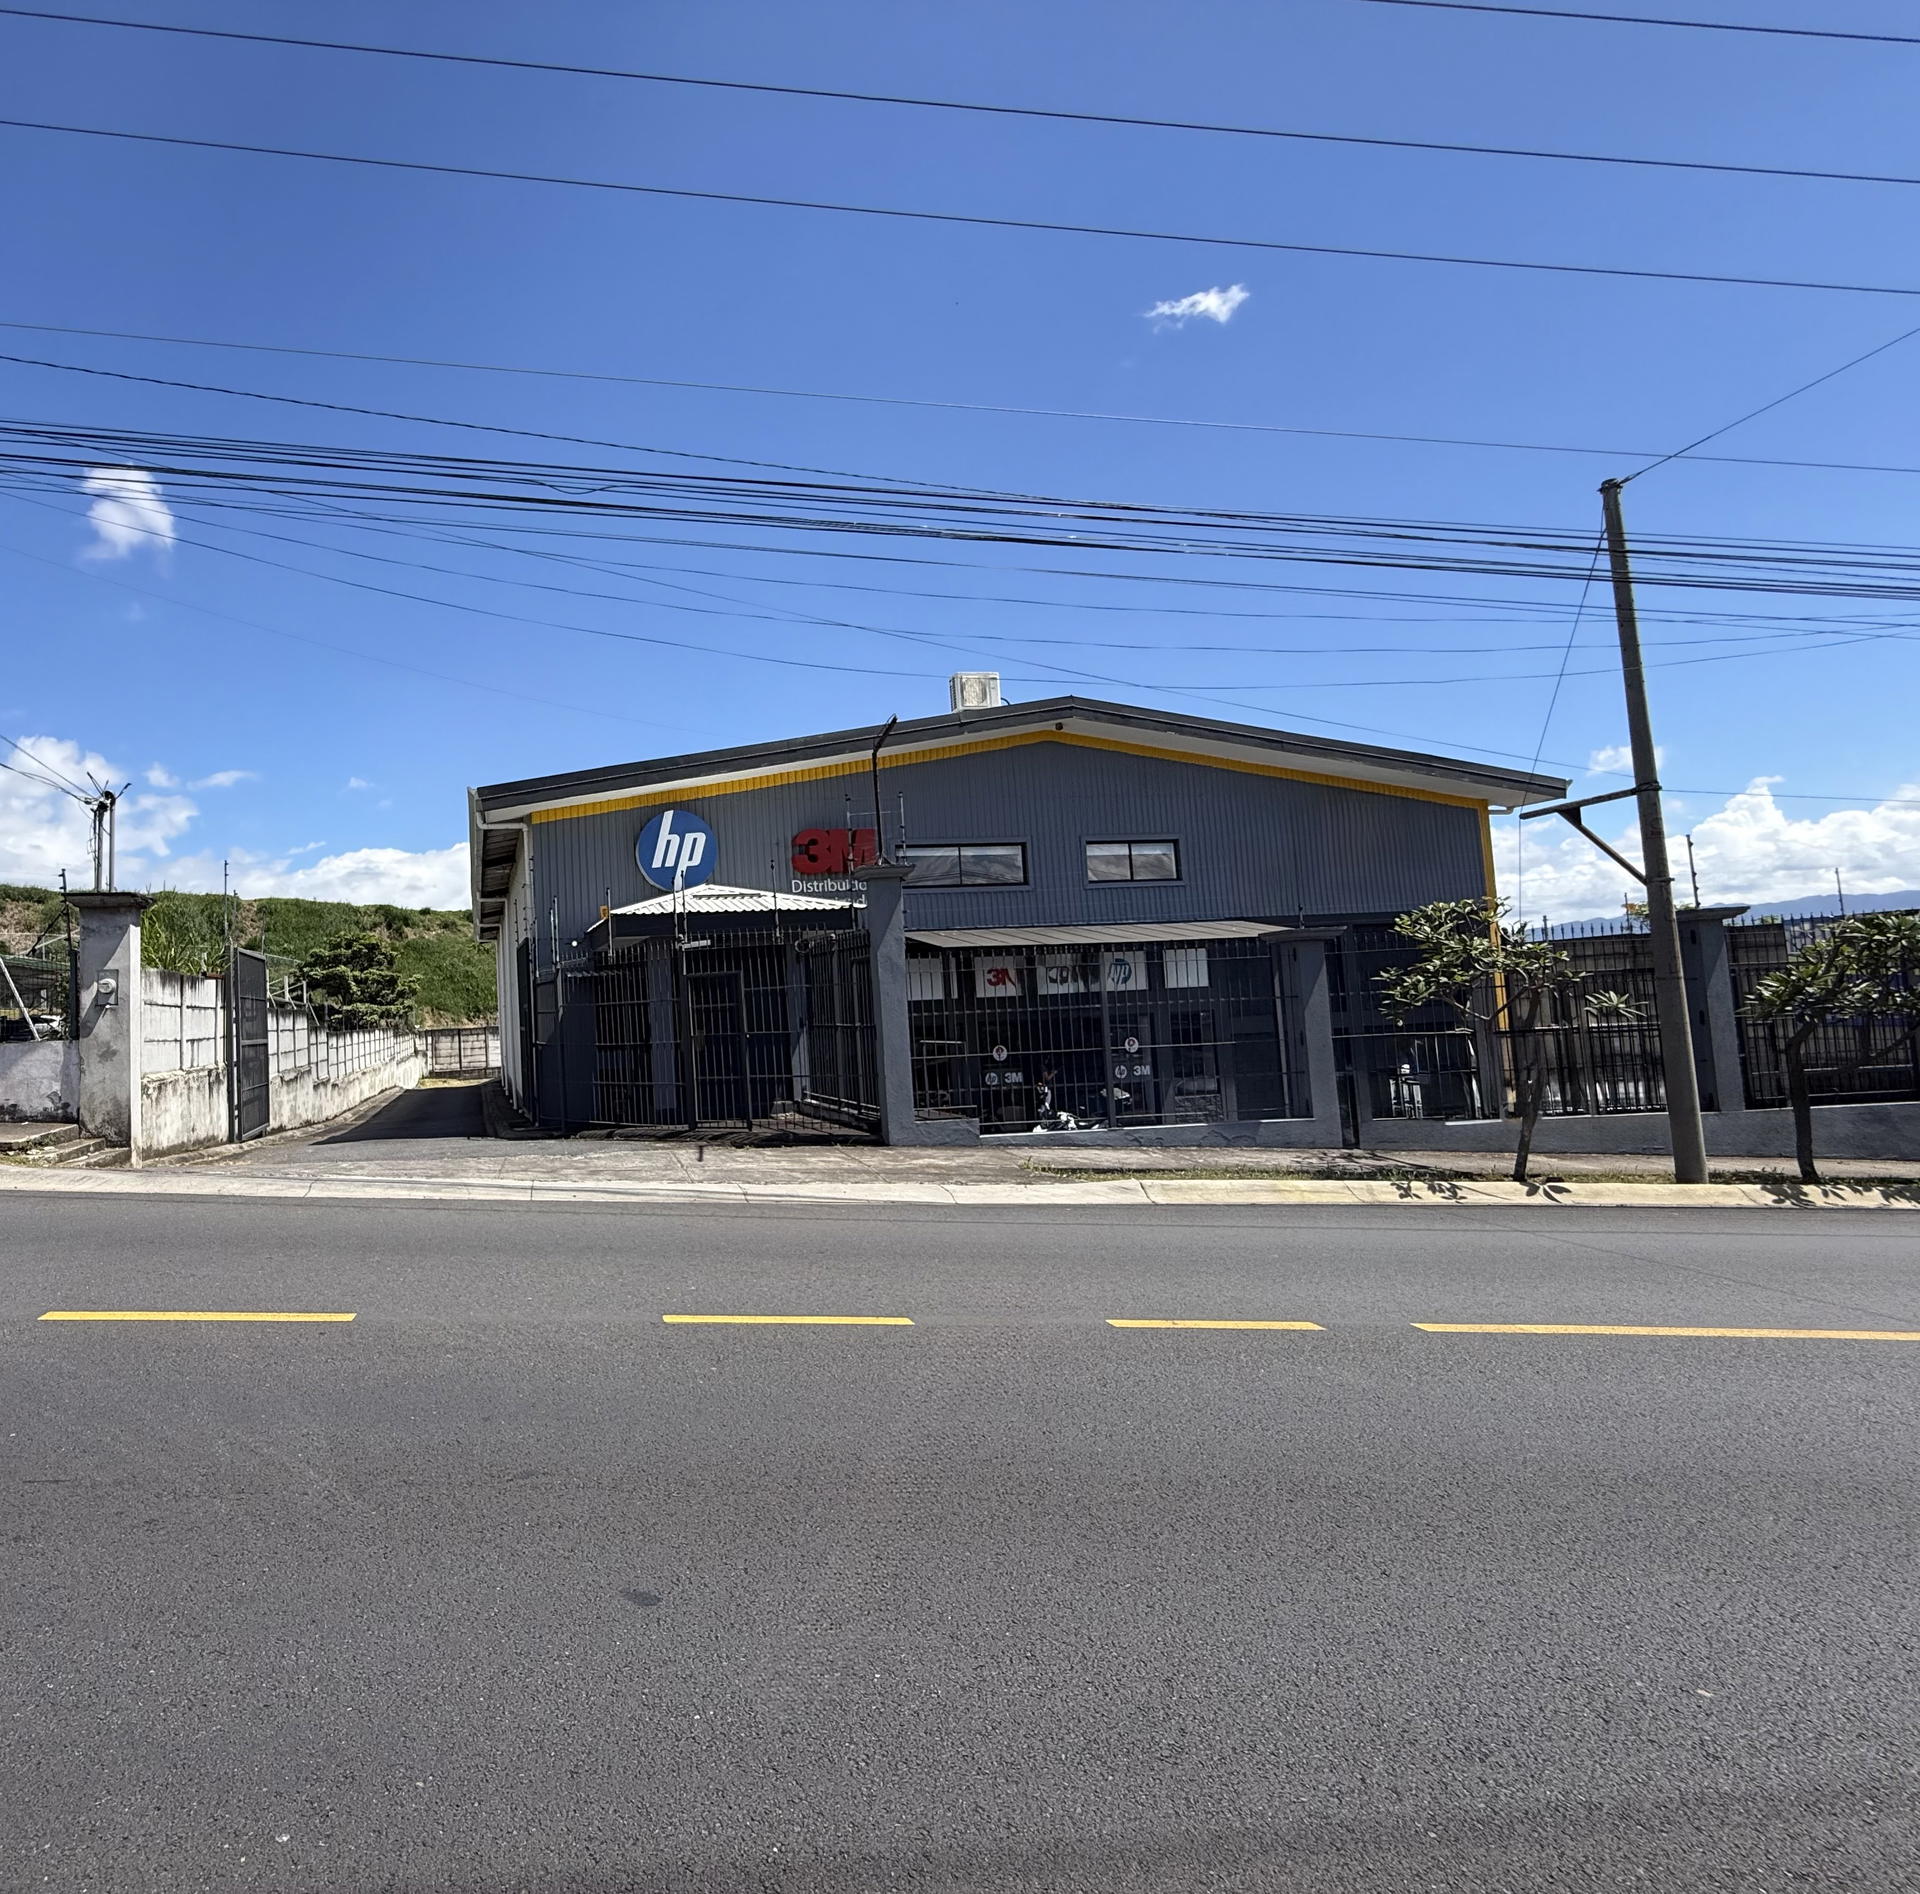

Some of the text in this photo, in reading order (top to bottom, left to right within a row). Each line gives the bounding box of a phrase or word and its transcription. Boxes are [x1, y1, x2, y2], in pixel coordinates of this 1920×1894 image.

[652, 810, 706, 891] hp
[792, 828, 876, 874] 3M
[791, 879, 868, 893] Distribuido
[1004, 1072, 1023, 1083] 3M
[1133, 1065, 1151, 1076] 3M
